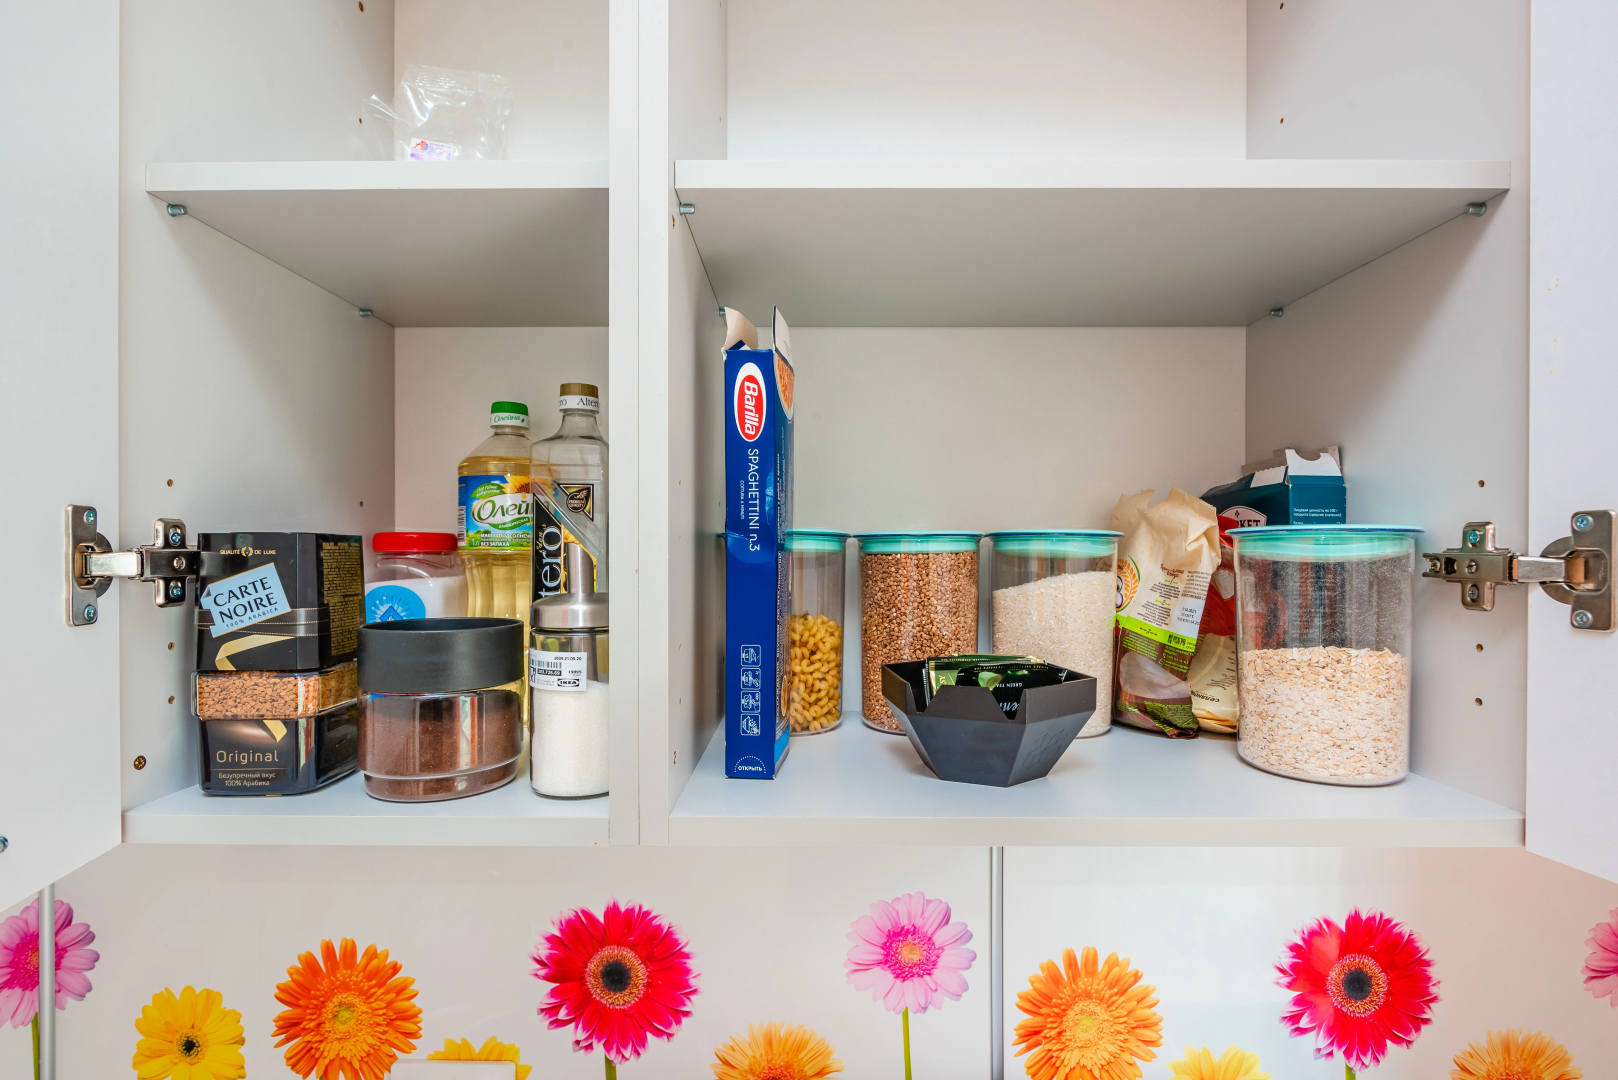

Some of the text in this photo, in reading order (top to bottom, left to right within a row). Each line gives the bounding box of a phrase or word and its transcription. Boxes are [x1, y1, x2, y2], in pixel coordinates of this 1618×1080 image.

[744, 381, 759, 436] Barilla
[748, 448, 760, 529] SPAGHETTINI
[213, 576, 272, 607] CARTE
[218, 592, 278, 624] NOIRE
[226, 607, 279, 628] 100% ARABICA
[216, 749, 279, 765] Original
